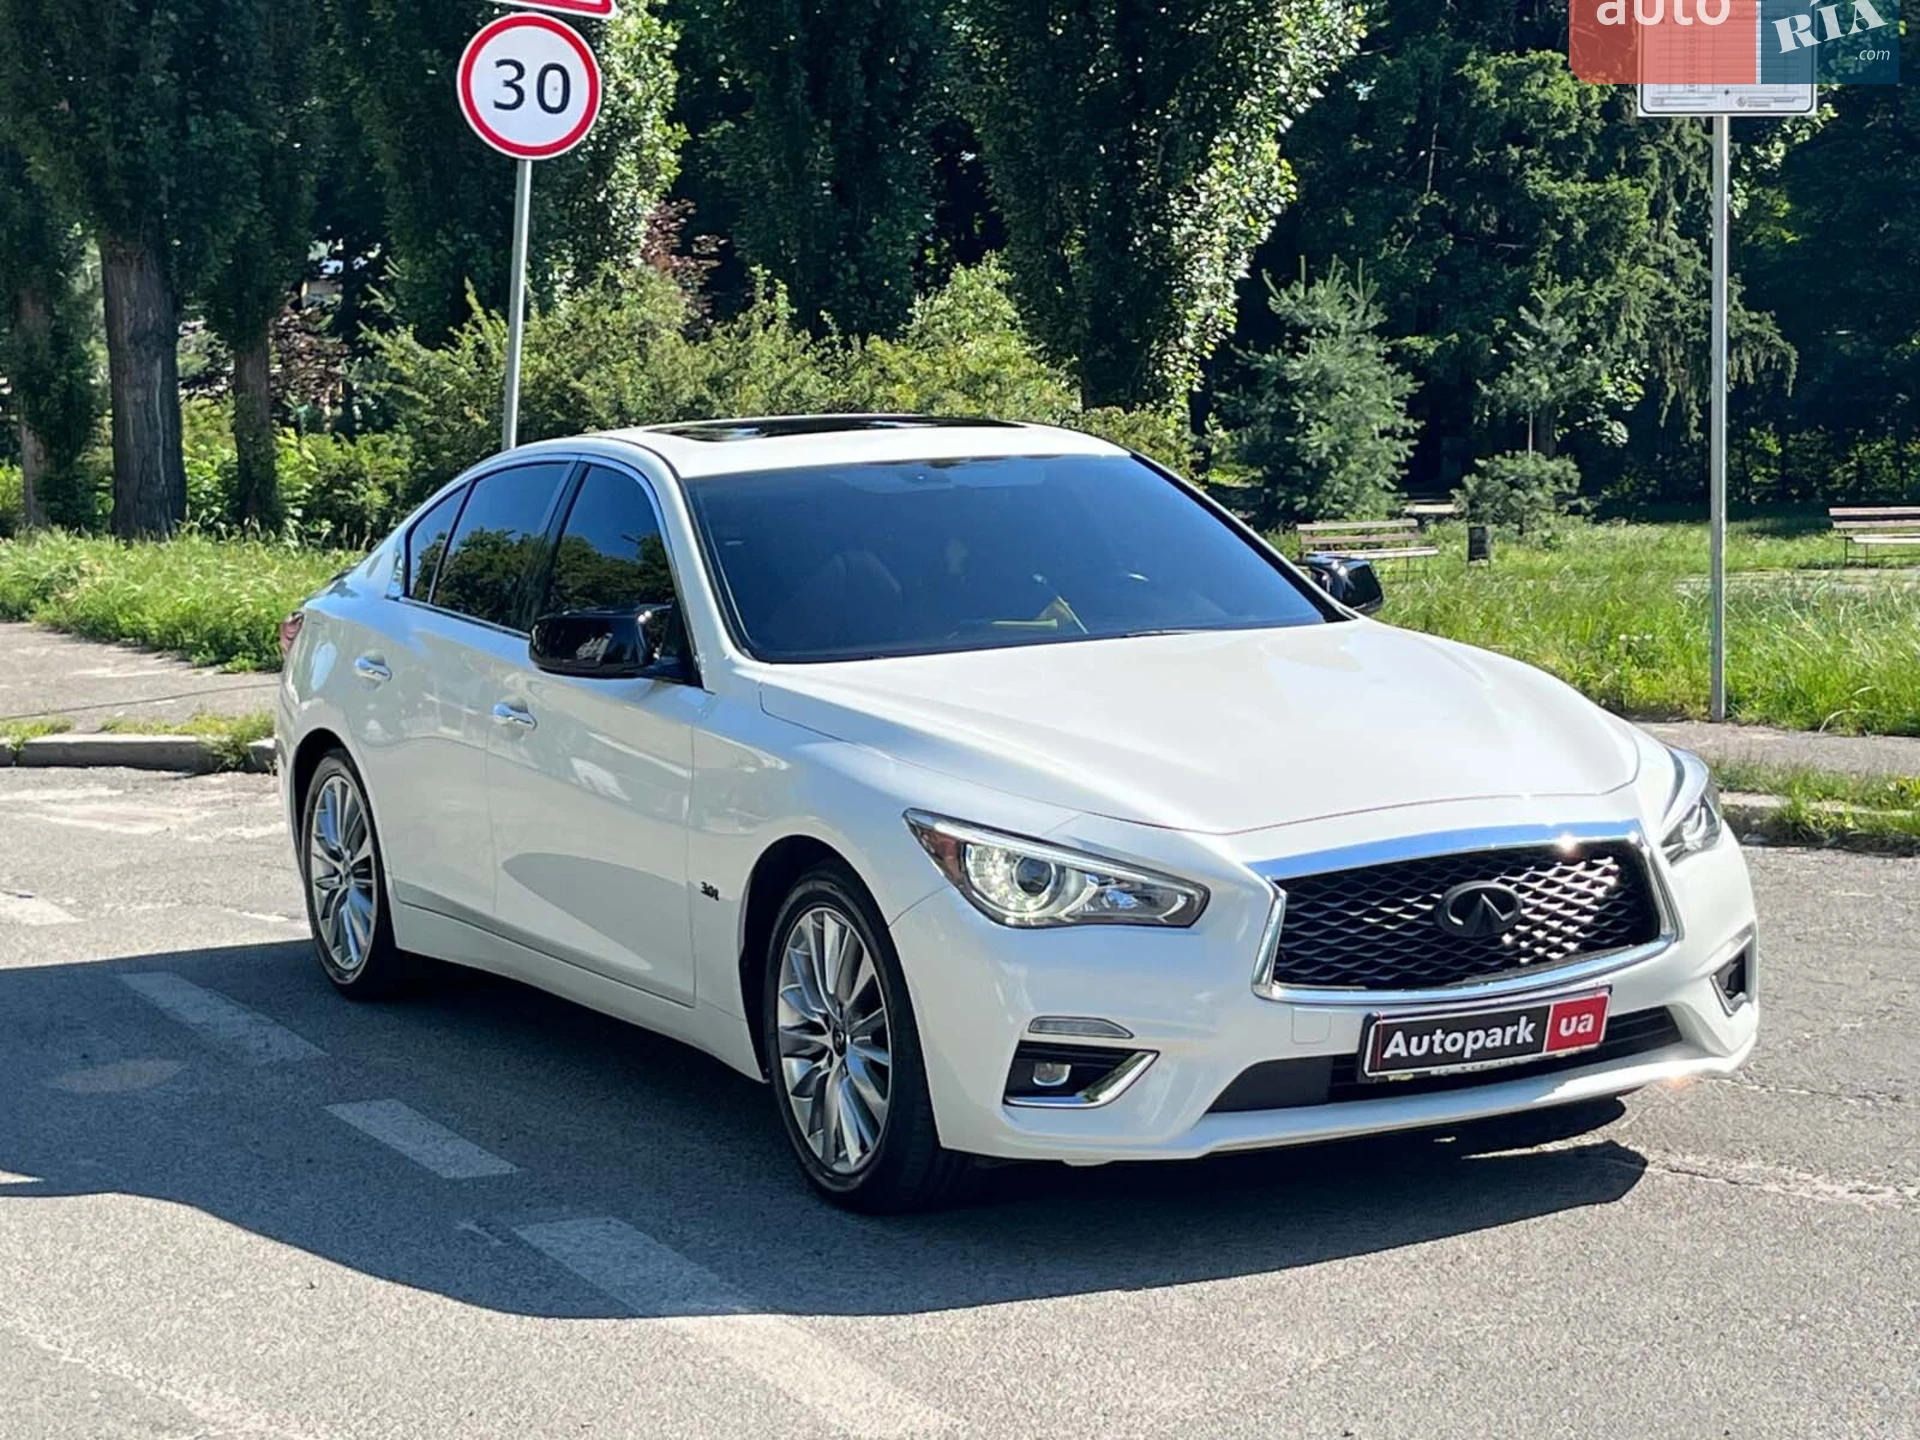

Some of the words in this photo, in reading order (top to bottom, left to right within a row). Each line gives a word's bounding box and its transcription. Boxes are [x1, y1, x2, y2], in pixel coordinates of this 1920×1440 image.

[493, 58, 571, 115] 30
[1382, 1015, 1537, 1059] Autopark
[1558, 1012, 1596, 1038] ua
